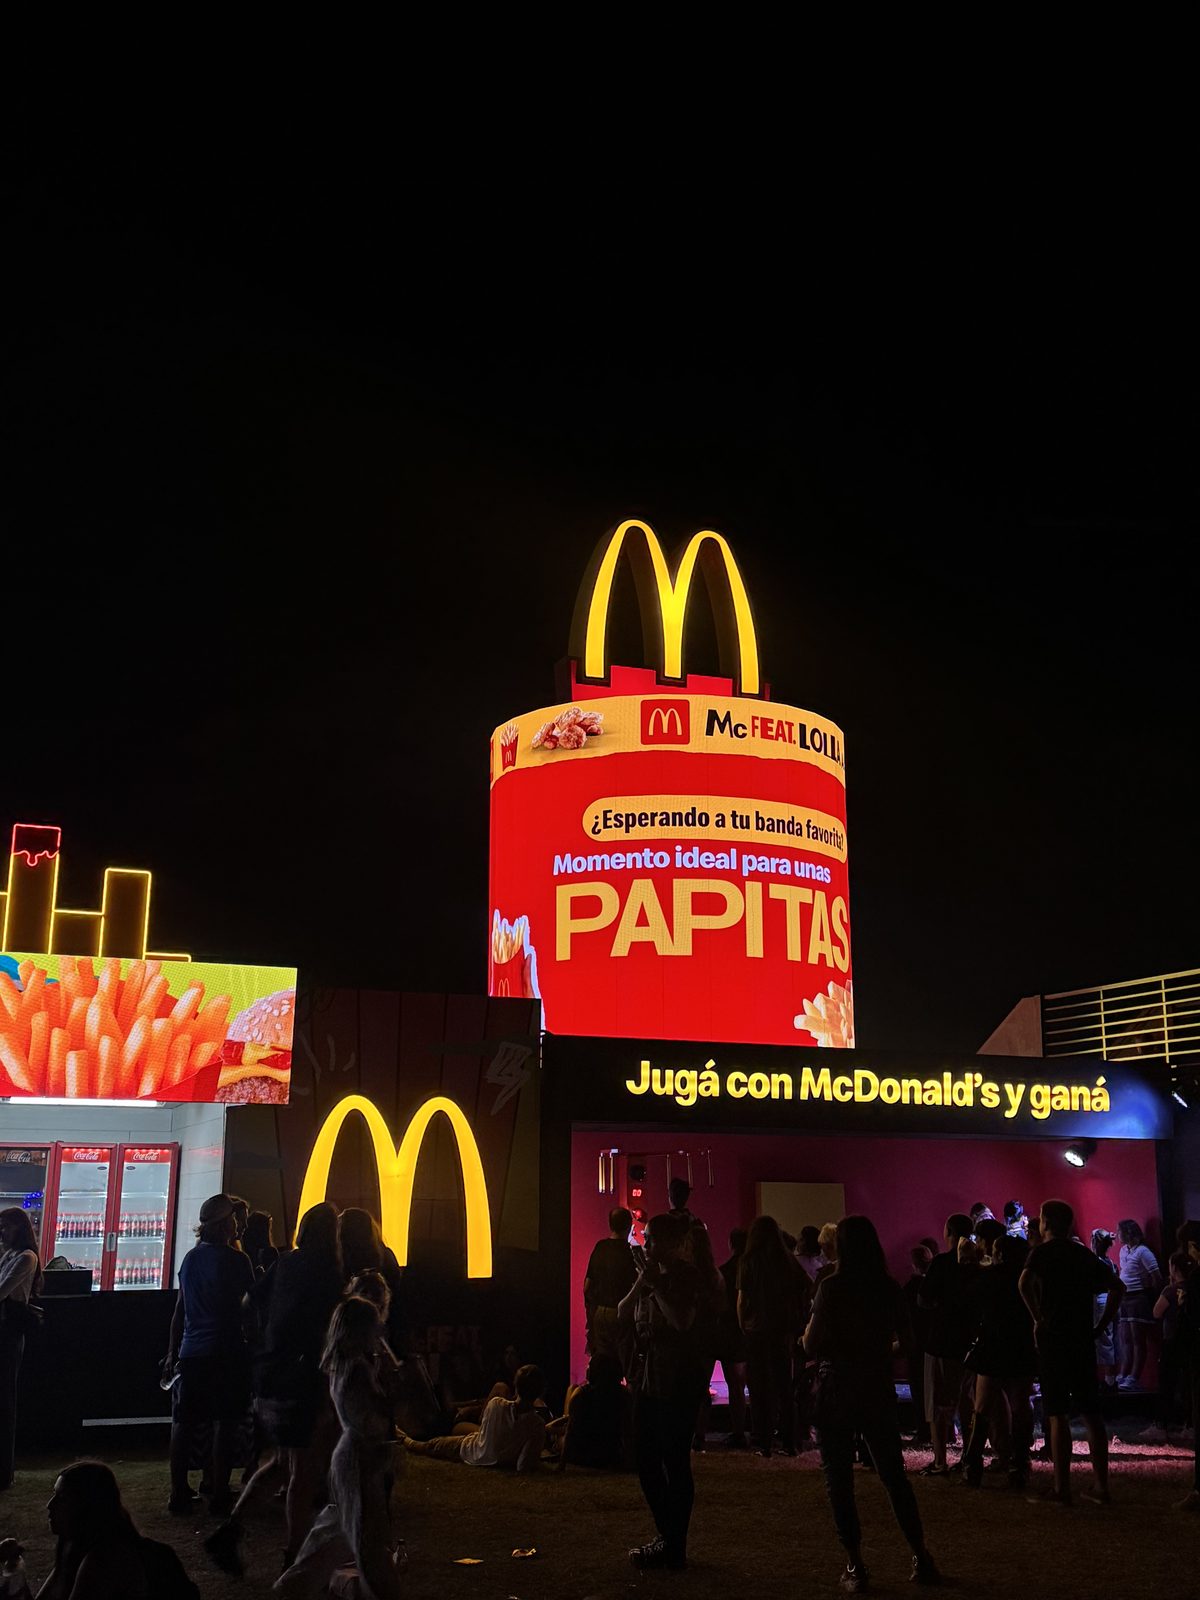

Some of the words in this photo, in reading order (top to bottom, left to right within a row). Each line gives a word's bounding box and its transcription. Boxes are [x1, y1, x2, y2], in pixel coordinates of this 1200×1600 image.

[705, 708, 748, 739] Mc
[751, 715, 797, 745] FEAT.
[591, 806, 710, 835] ¿Esperando
[714, 812, 726, 829] a
[731, 810, 750, 830] tu
[755, 810, 803, 838] banda
[805, 819, 844, 851] favorita?
[553, 847, 670, 876] Momento
[675, 845, 737, 870] ideal
[742, 854, 792, 877] para
[794, 862, 832, 884] unas
[555, 878, 850, 973] PAPITAS
[625, 1058, 720, 1107] Jugá
[726, 1070, 793, 1100] con
[799, 1066, 1000, 1109] McDonald's
[1003, 1082, 1026, 1119] y
[1030, 1075, 1110, 1120] ganá
